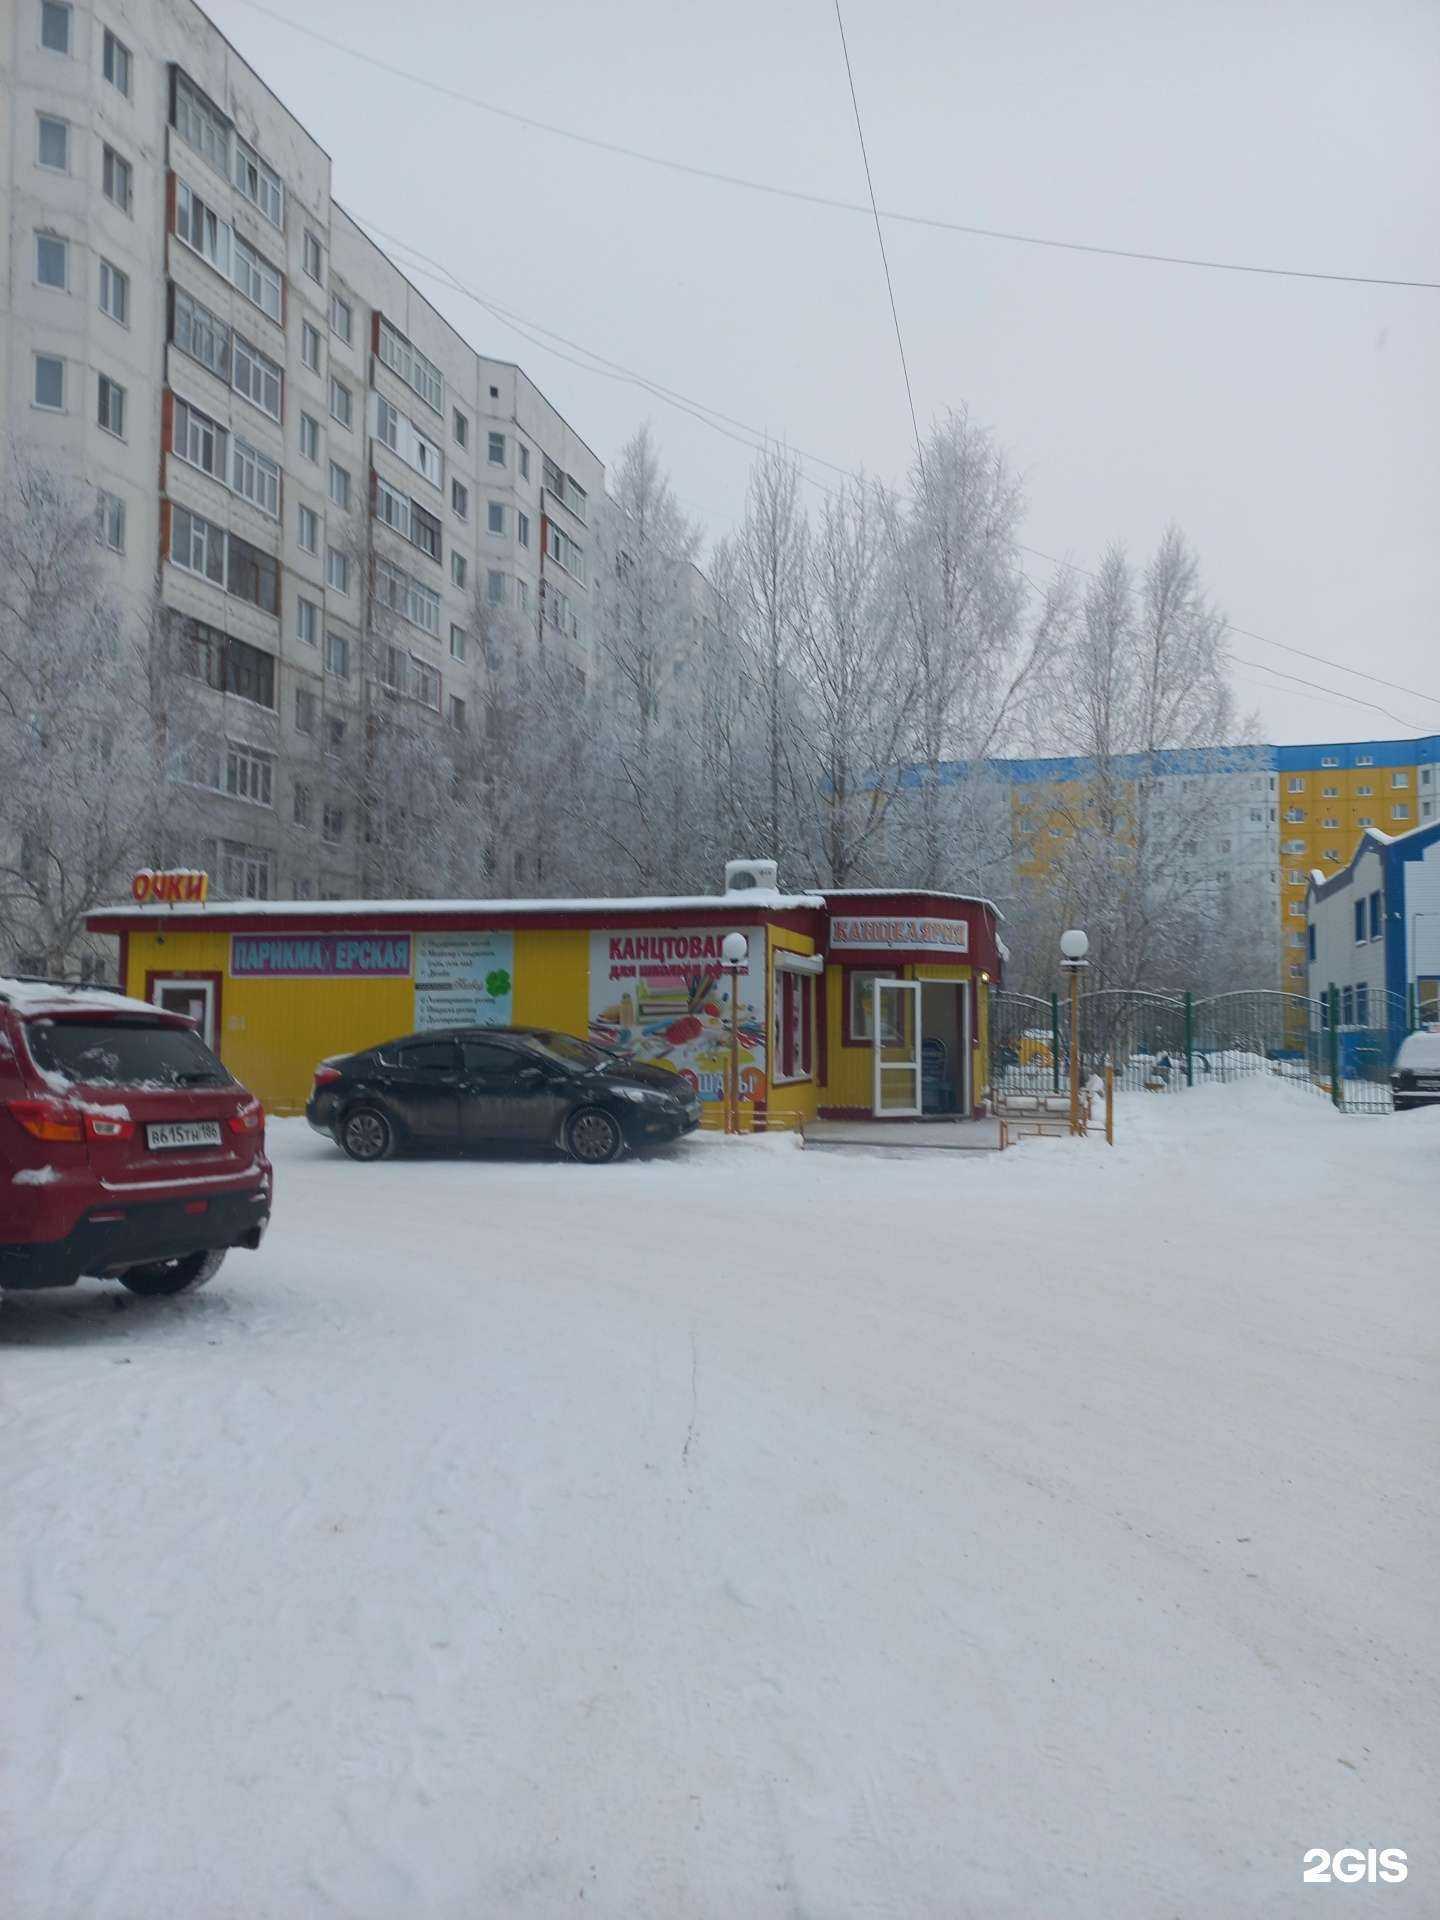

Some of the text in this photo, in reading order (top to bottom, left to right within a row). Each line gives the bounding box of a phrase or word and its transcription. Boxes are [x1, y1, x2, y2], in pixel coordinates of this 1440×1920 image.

[132, 872, 207, 902] ОЧКИ
[234, 941, 409, 970] ПАРИКМАЕРСКАЯ
[609, 935, 749, 962] КАНЦТОВА
